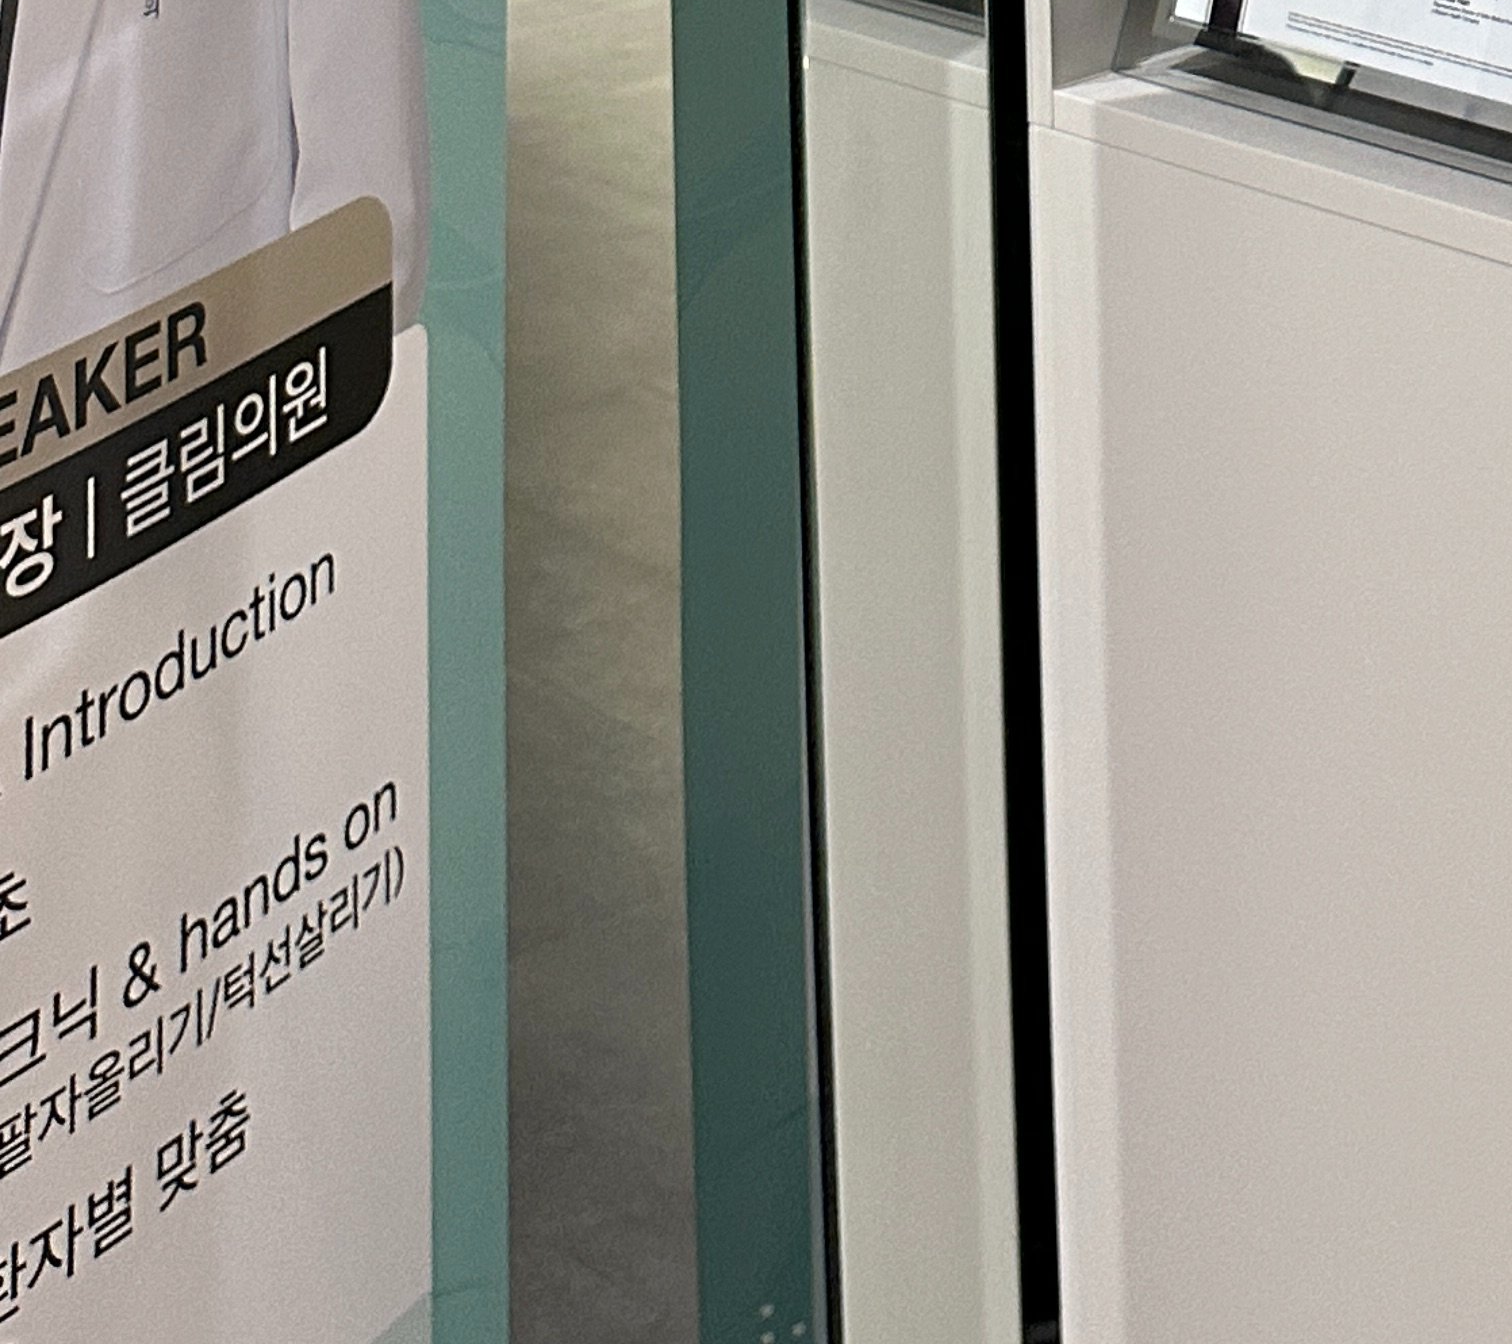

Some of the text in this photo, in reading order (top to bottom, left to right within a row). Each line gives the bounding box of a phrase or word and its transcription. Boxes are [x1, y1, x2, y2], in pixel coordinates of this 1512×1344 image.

[120, 345, 328, 539] 클림의원
[24, 551, 336, 781] Introduction
[122, 940, 163, 1009] &
[179, 832, 329, 975] hands
[343, 780, 398, 851] on
[156, 1088, 251, 1213] 맞춤
